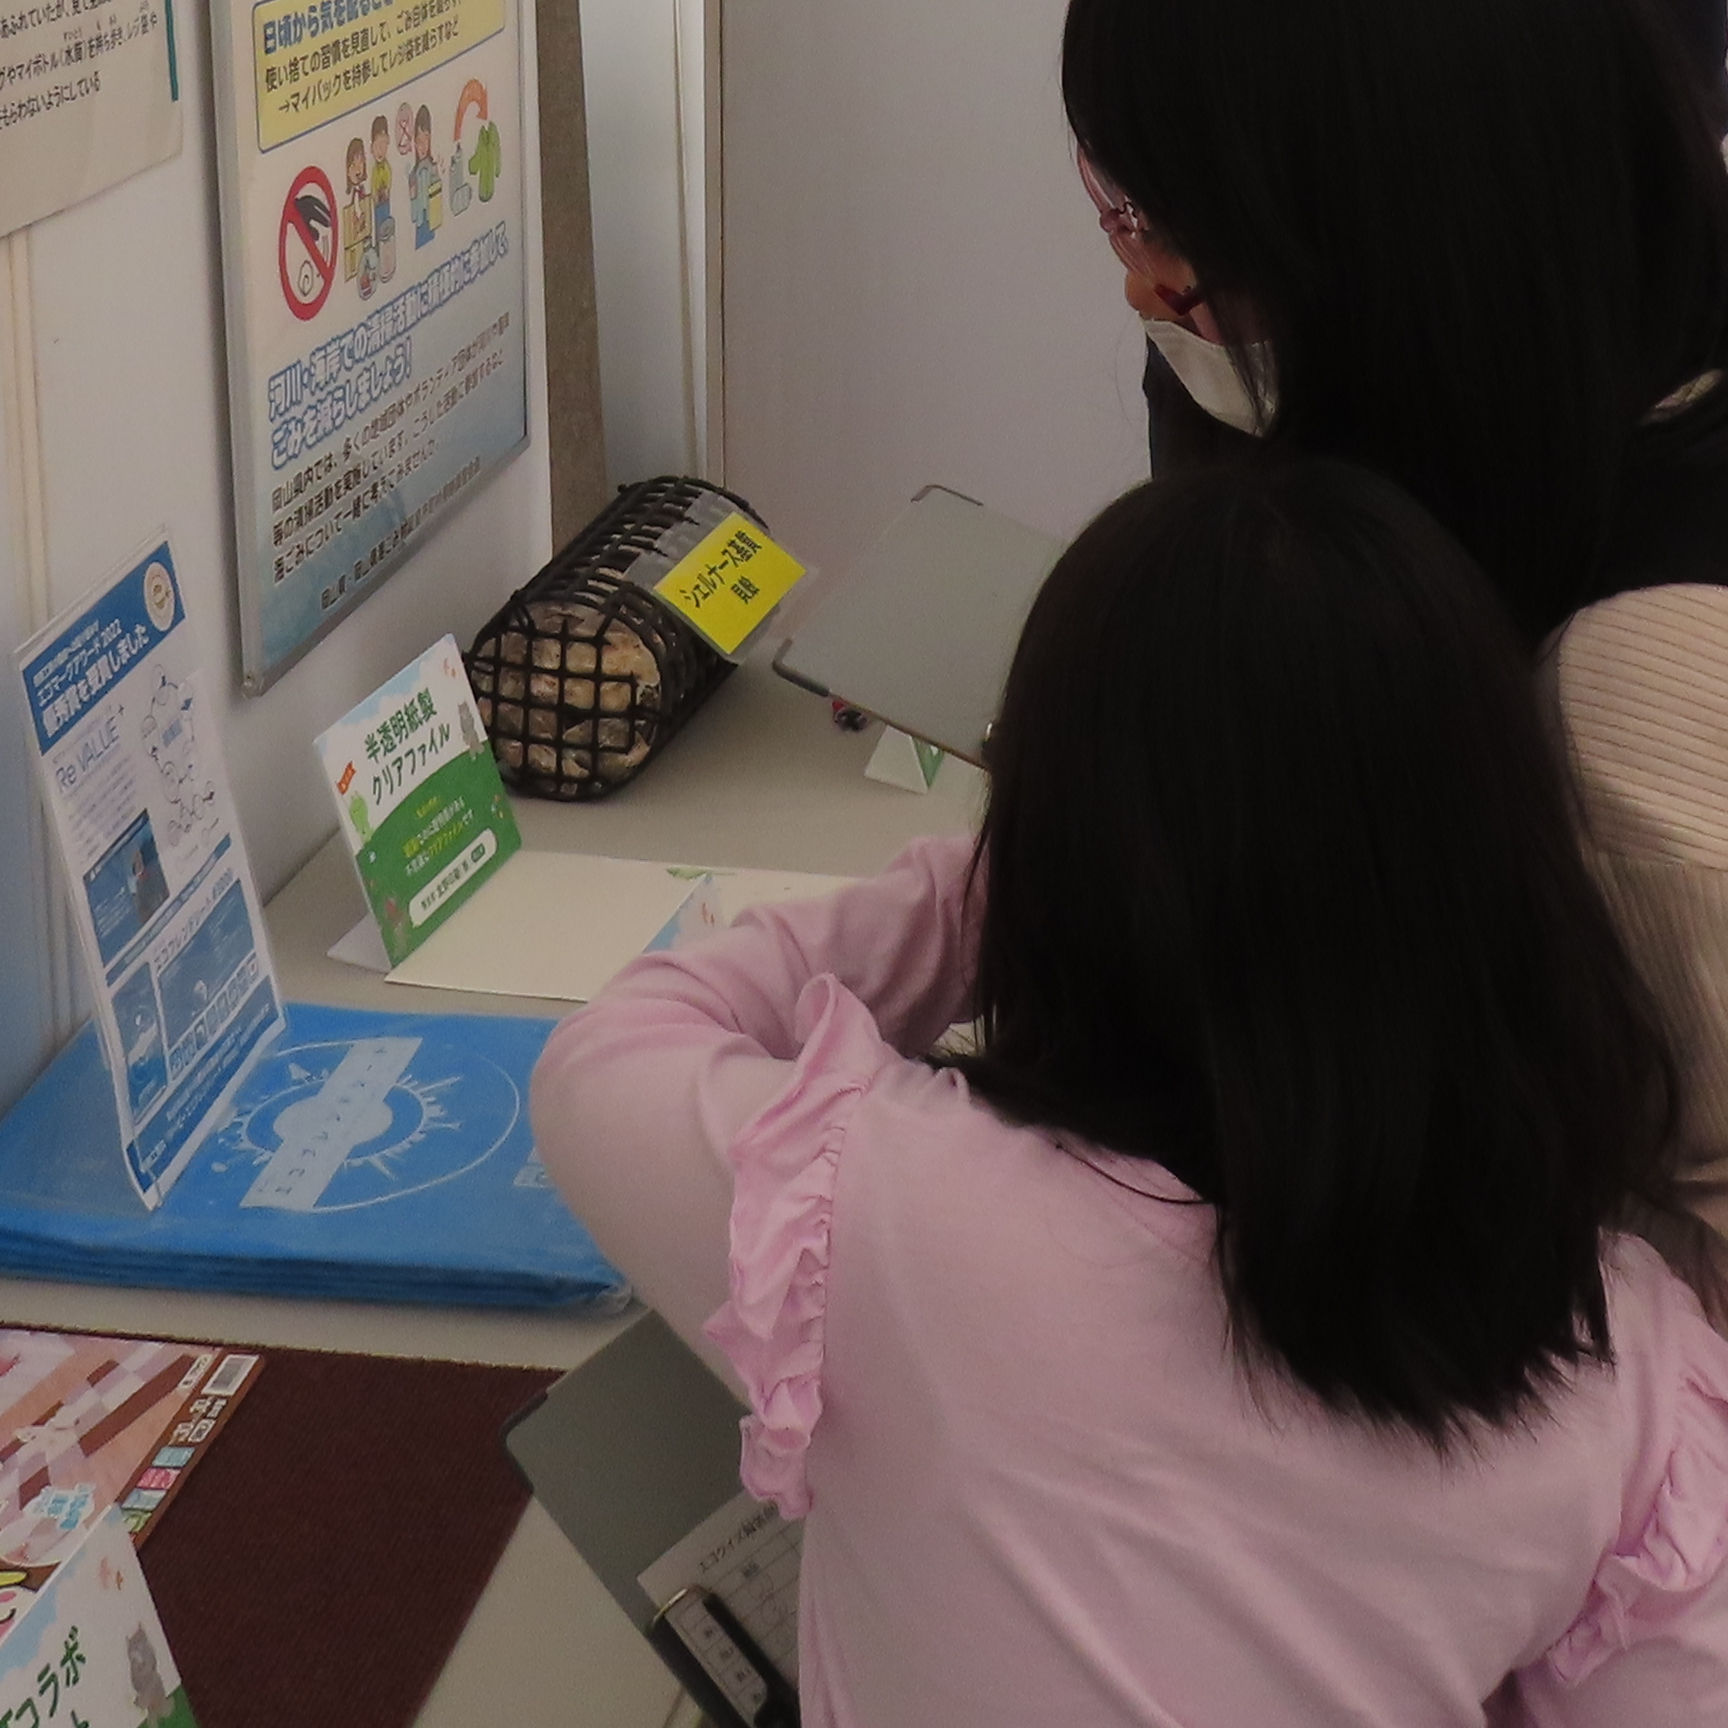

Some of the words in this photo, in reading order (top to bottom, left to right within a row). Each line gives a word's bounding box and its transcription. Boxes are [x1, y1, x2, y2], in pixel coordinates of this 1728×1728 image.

[364, 687, 438, 765] 半透明紙製
[372, 722, 451, 806] クリアファイル
